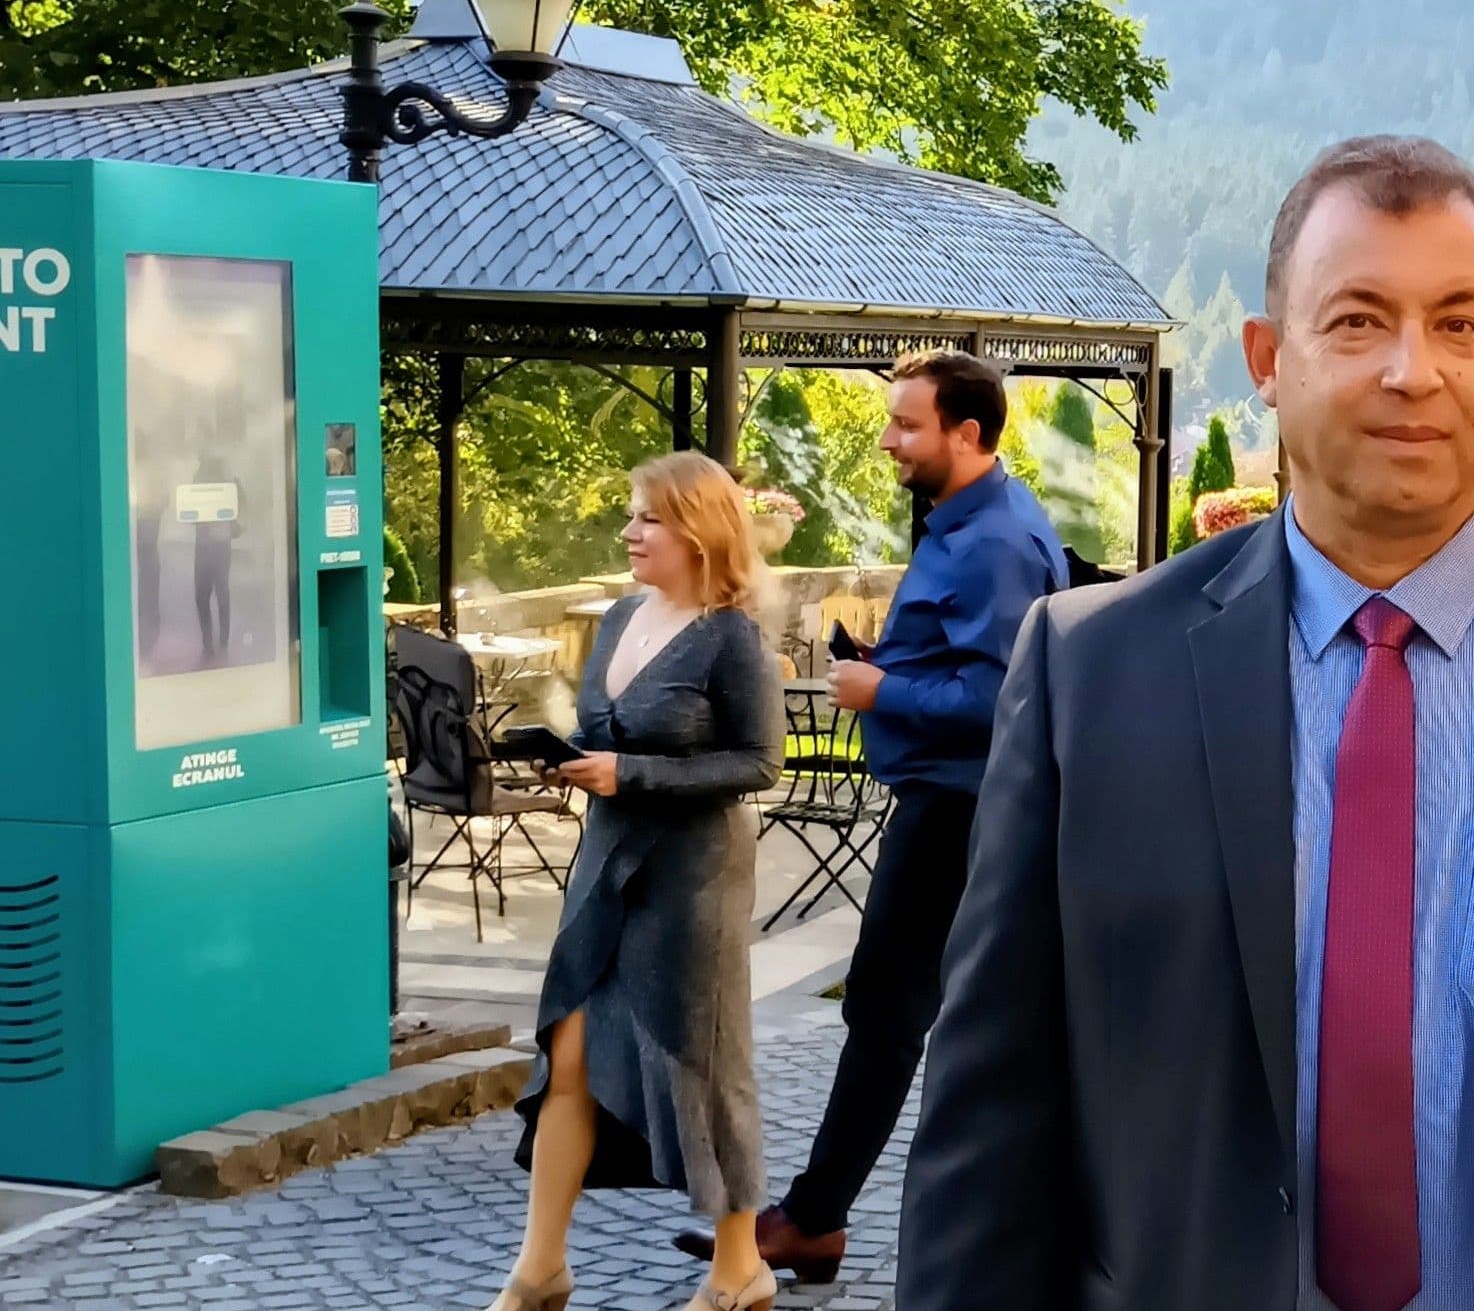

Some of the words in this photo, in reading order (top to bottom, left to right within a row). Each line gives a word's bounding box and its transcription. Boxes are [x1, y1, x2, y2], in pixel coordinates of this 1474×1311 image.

[0, 247, 71, 296] TO
[181, 749, 237, 770] ATINGE
[172, 764, 245, 788] ECRANUL
